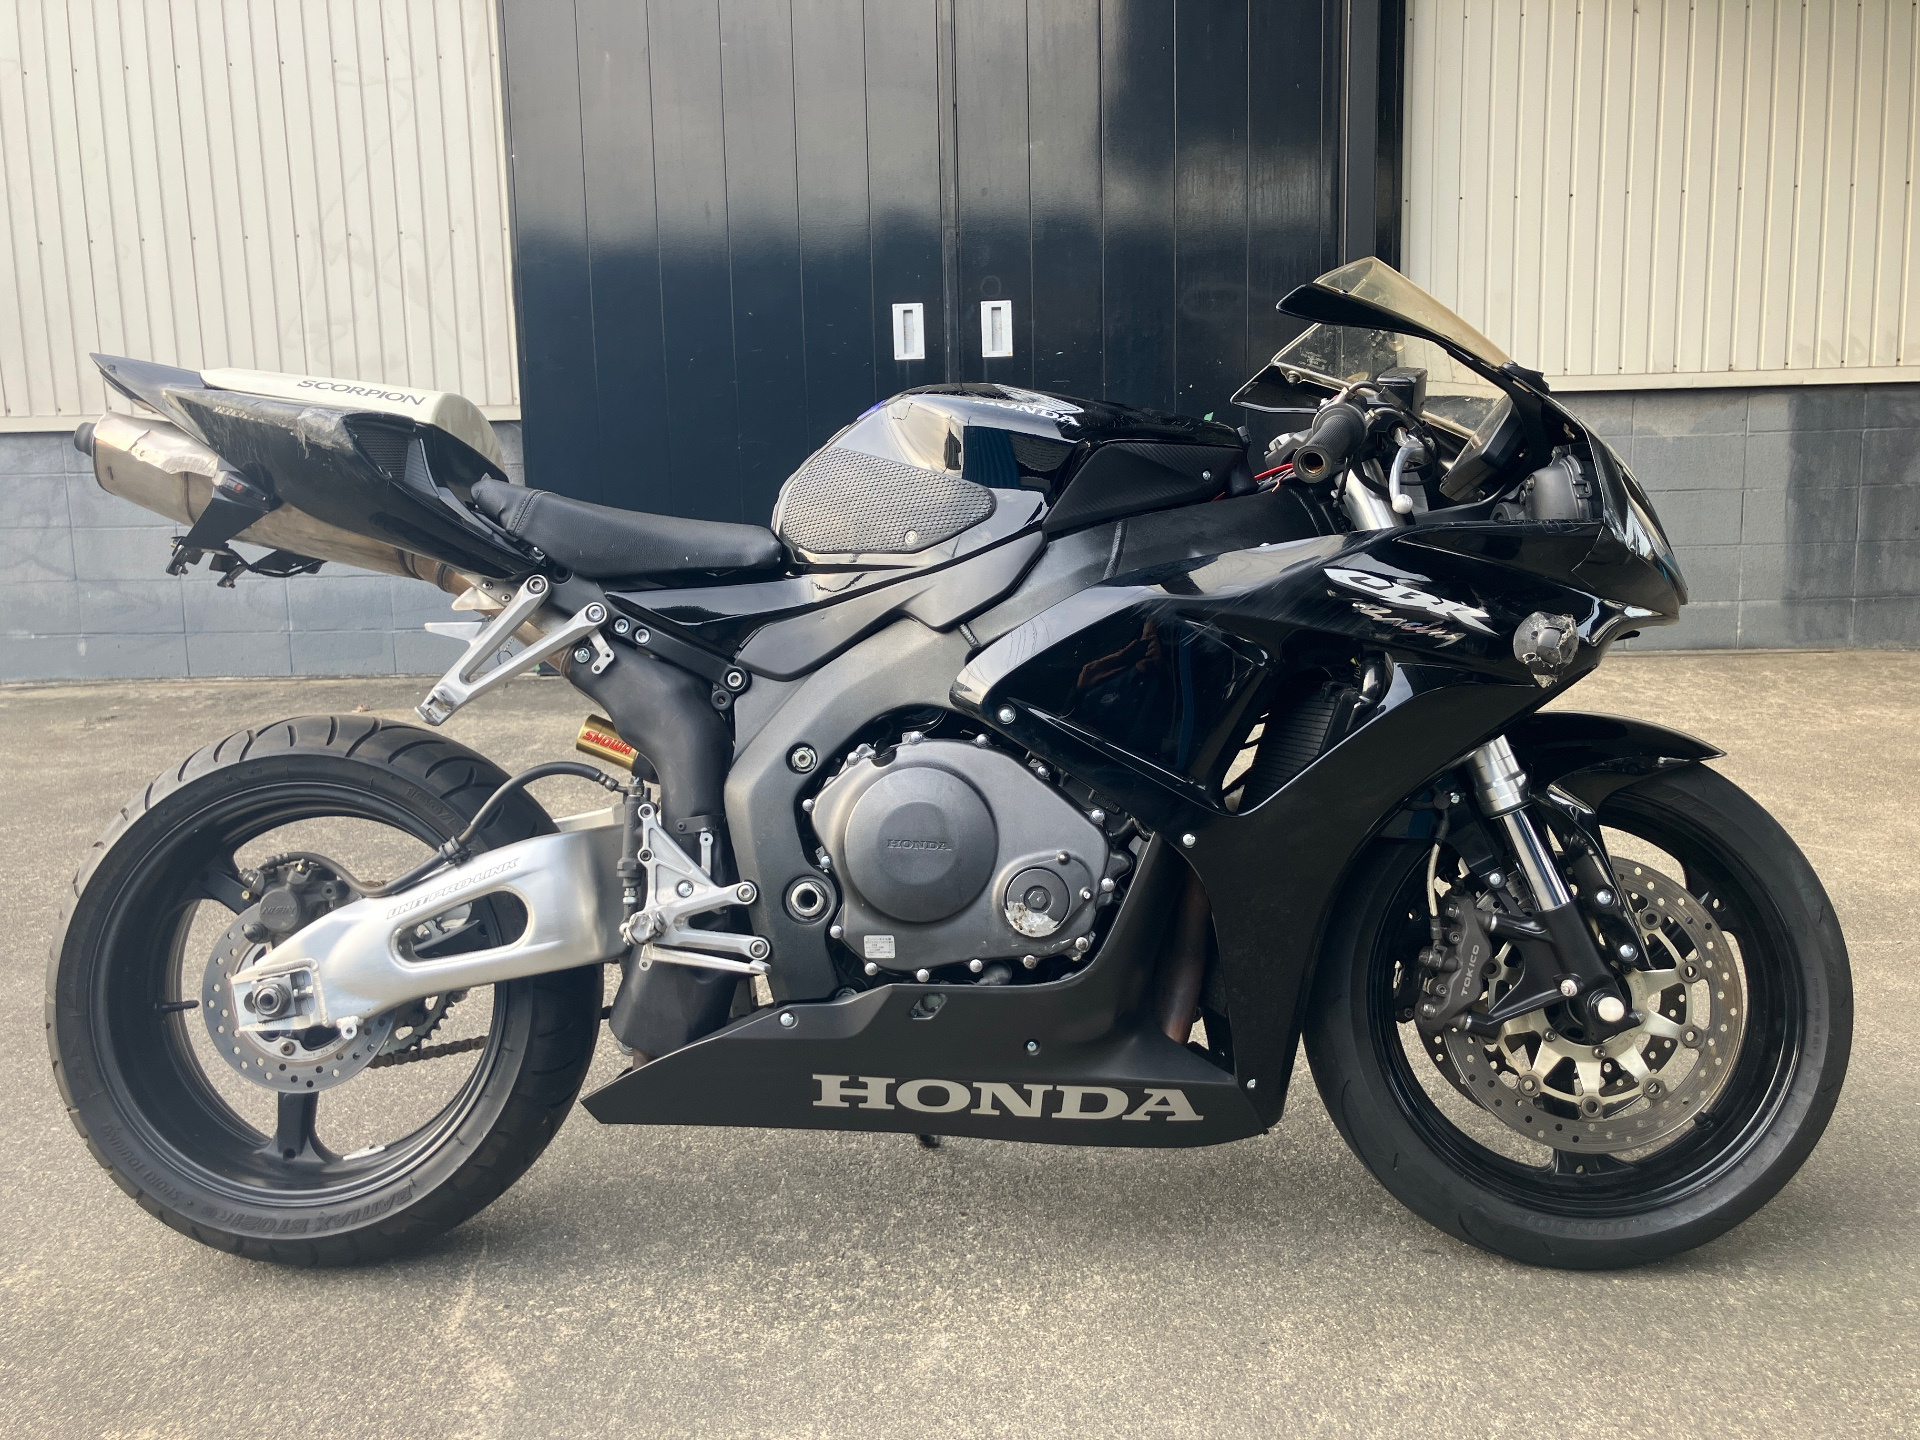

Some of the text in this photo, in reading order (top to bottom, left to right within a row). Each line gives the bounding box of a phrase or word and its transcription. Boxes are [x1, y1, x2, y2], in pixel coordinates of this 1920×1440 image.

[296, 379, 427, 406] SCORPION
[582, 729, 633, 755] SHOWA
[886, 838, 952, 851] HONDA
[386, 893, 431, 920] UNIT
[1460, 944, 1480, 997] TOKICO
[812, 1073, 1205, 1122] HONDA
